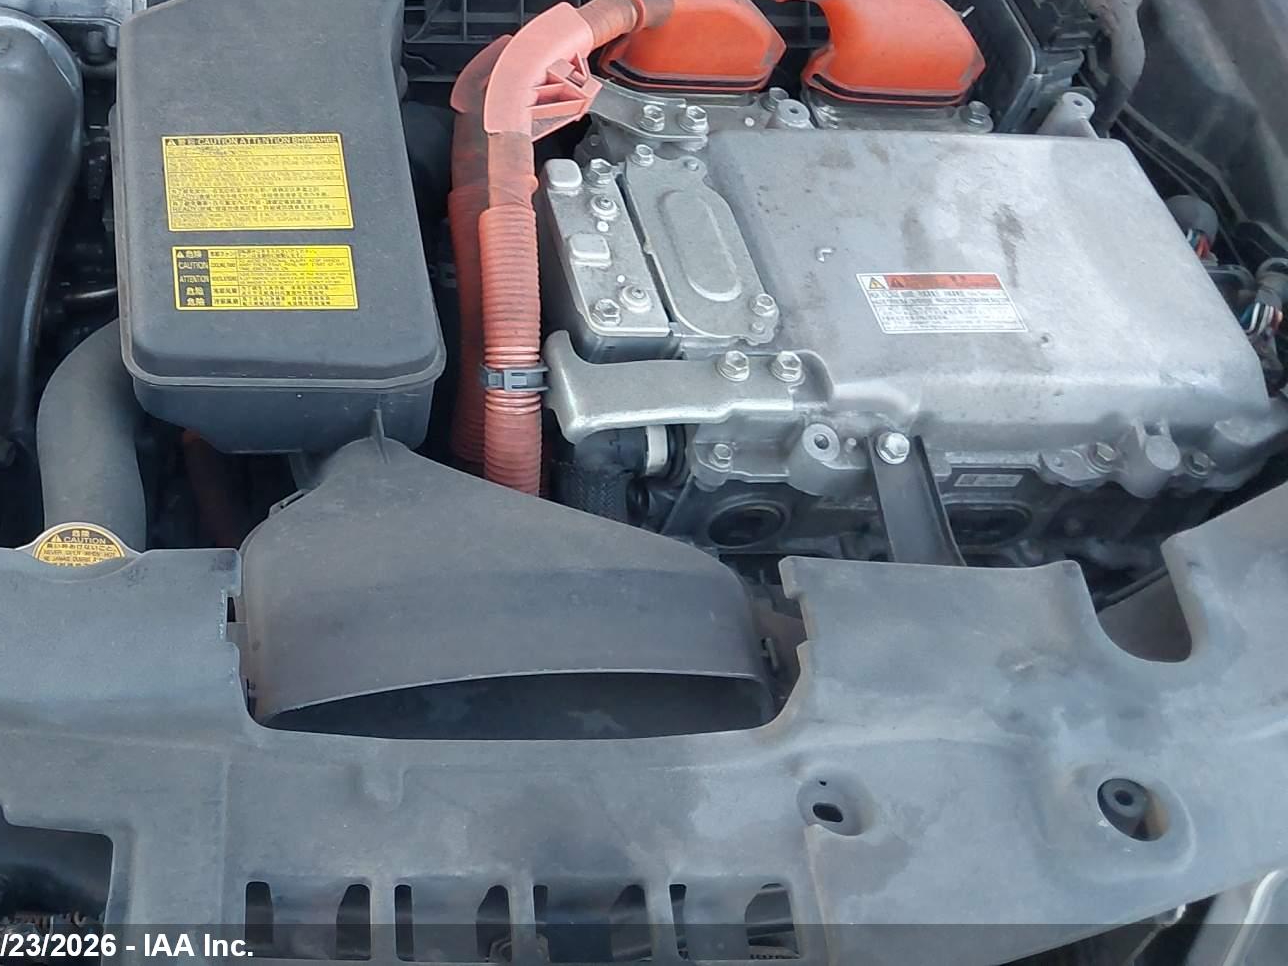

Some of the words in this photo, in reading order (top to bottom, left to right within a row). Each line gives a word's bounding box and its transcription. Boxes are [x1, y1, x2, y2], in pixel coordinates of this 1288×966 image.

[197, 137, 238, 146] CAUTION
[239, 136, 290, 145] ATTENTION
[178, 261, 209, 270] CAUTION
[179, 275, 209, 283] ATTENTION
[63, 536, 106, 544] CAUTION
